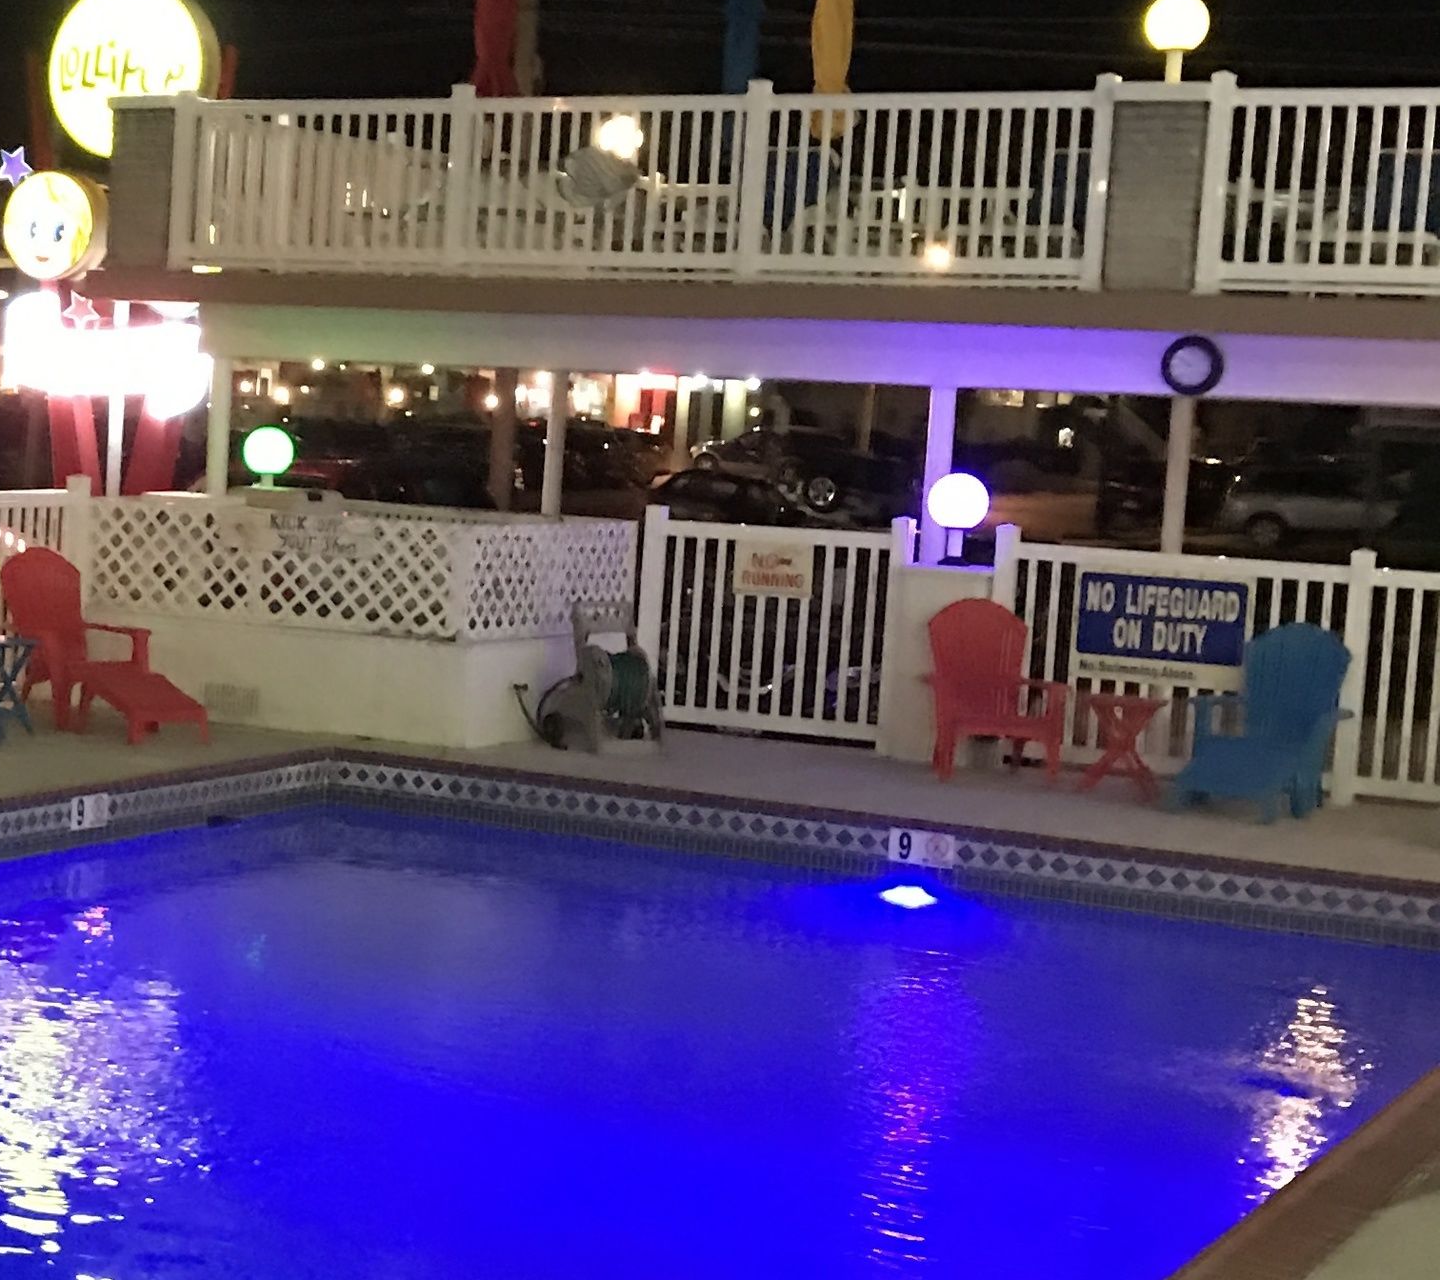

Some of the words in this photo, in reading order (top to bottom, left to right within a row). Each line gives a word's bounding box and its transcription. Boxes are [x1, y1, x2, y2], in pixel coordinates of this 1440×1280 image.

[741, 570, 804, 588] RUNNING
[1086, 580, 1116, 612] NO
[1124, 583, 1240, 623] LIFEGUARD
[1112, 617, 1143, 650] ON
[1152, 621, 1208, 655] DUTY
[77, 798, 85, 826] 9
[899, 832, 912, 860] 9
